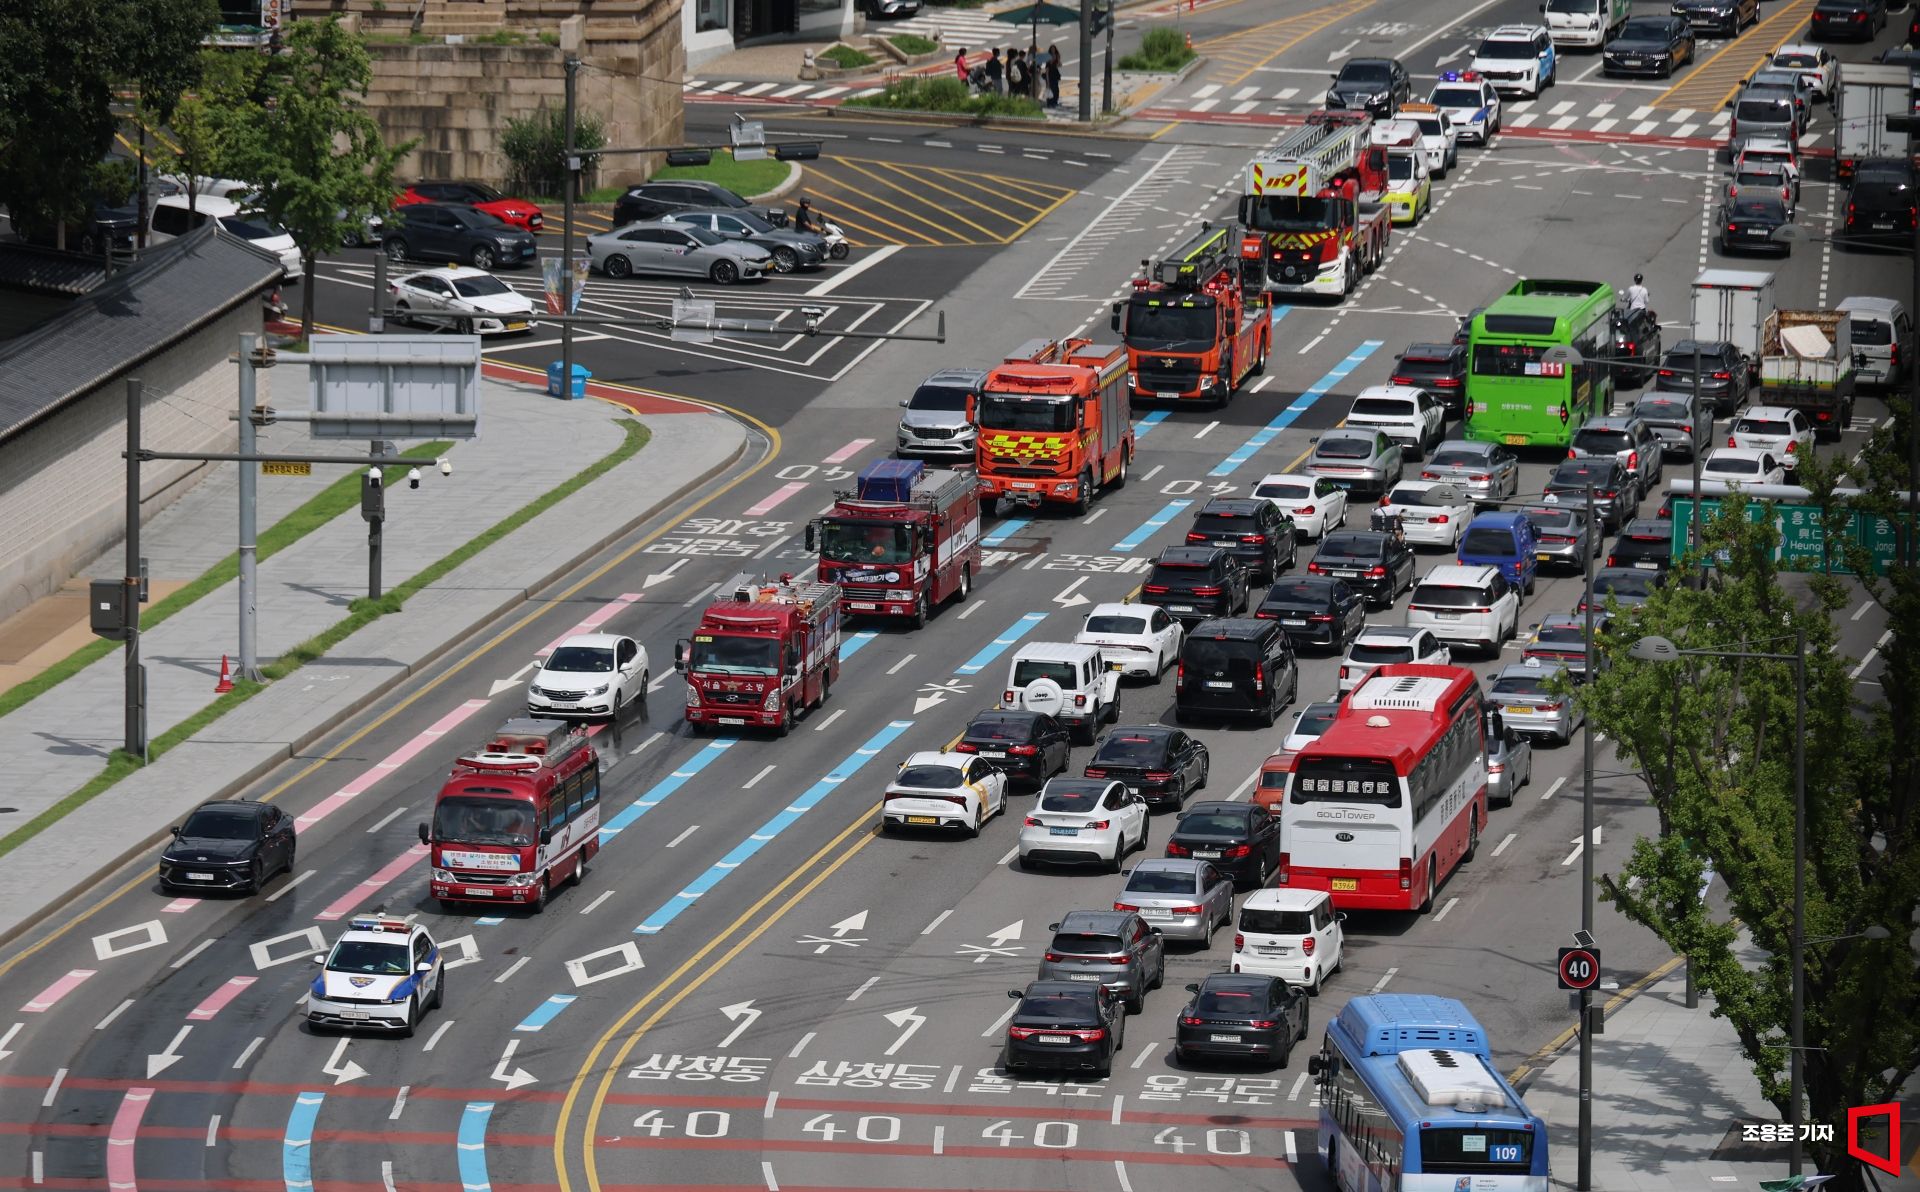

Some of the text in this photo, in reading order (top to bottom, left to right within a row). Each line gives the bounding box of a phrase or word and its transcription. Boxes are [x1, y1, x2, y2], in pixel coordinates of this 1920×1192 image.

[1265, 173, 1297, 188] 119
[775, 464, 855, 482] 40
[1159, 480, 1239, 496] 40
[702, 680, 764, 692] 서울 소방
[1568, 960, 1590, 978] 40
[628, 1053, 773, 1083] 삼청동
[795, 1060, 941, 1090] 삼청동
[1138, 1074, 1282, 1105] 율곡로
[633, 1109, 731, 1138] 40
[802, 1113, 902, 1142] 40
[981, 1120, 1079, 1148] 40
[1153, 1126, 1251, 1155] 40
[1495, 1146, 1518, 1160] 109
